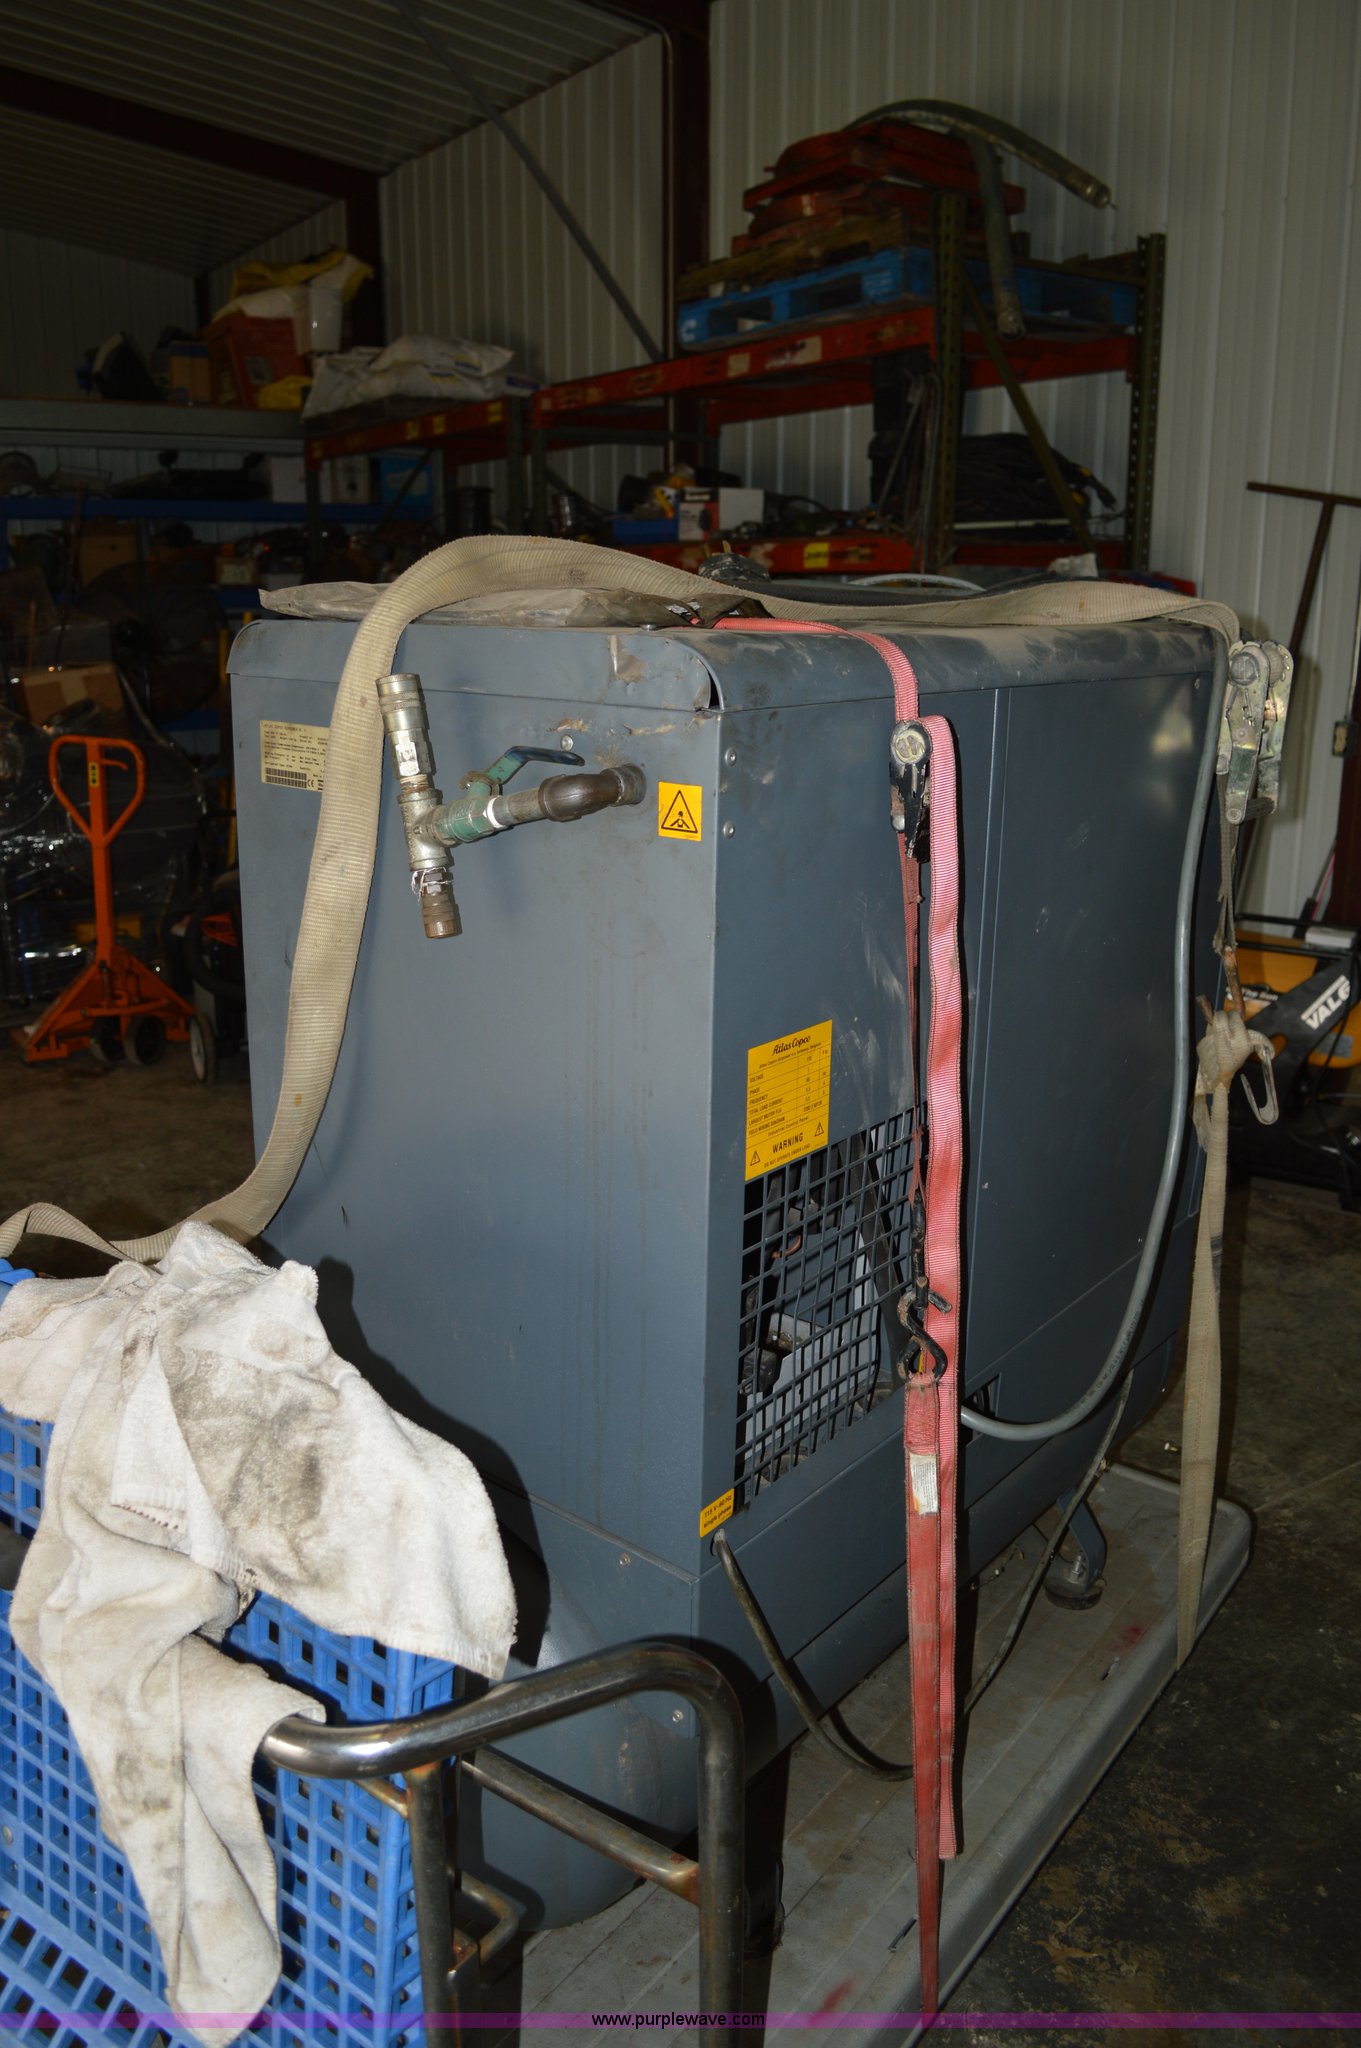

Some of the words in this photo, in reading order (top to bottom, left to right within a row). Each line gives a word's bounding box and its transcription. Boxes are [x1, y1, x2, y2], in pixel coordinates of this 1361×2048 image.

[772, 1043, 791, 1056] Atlas
[792, 1035, 810, 1048] Copco
[772, 1131, 803, 1154] WARNING
